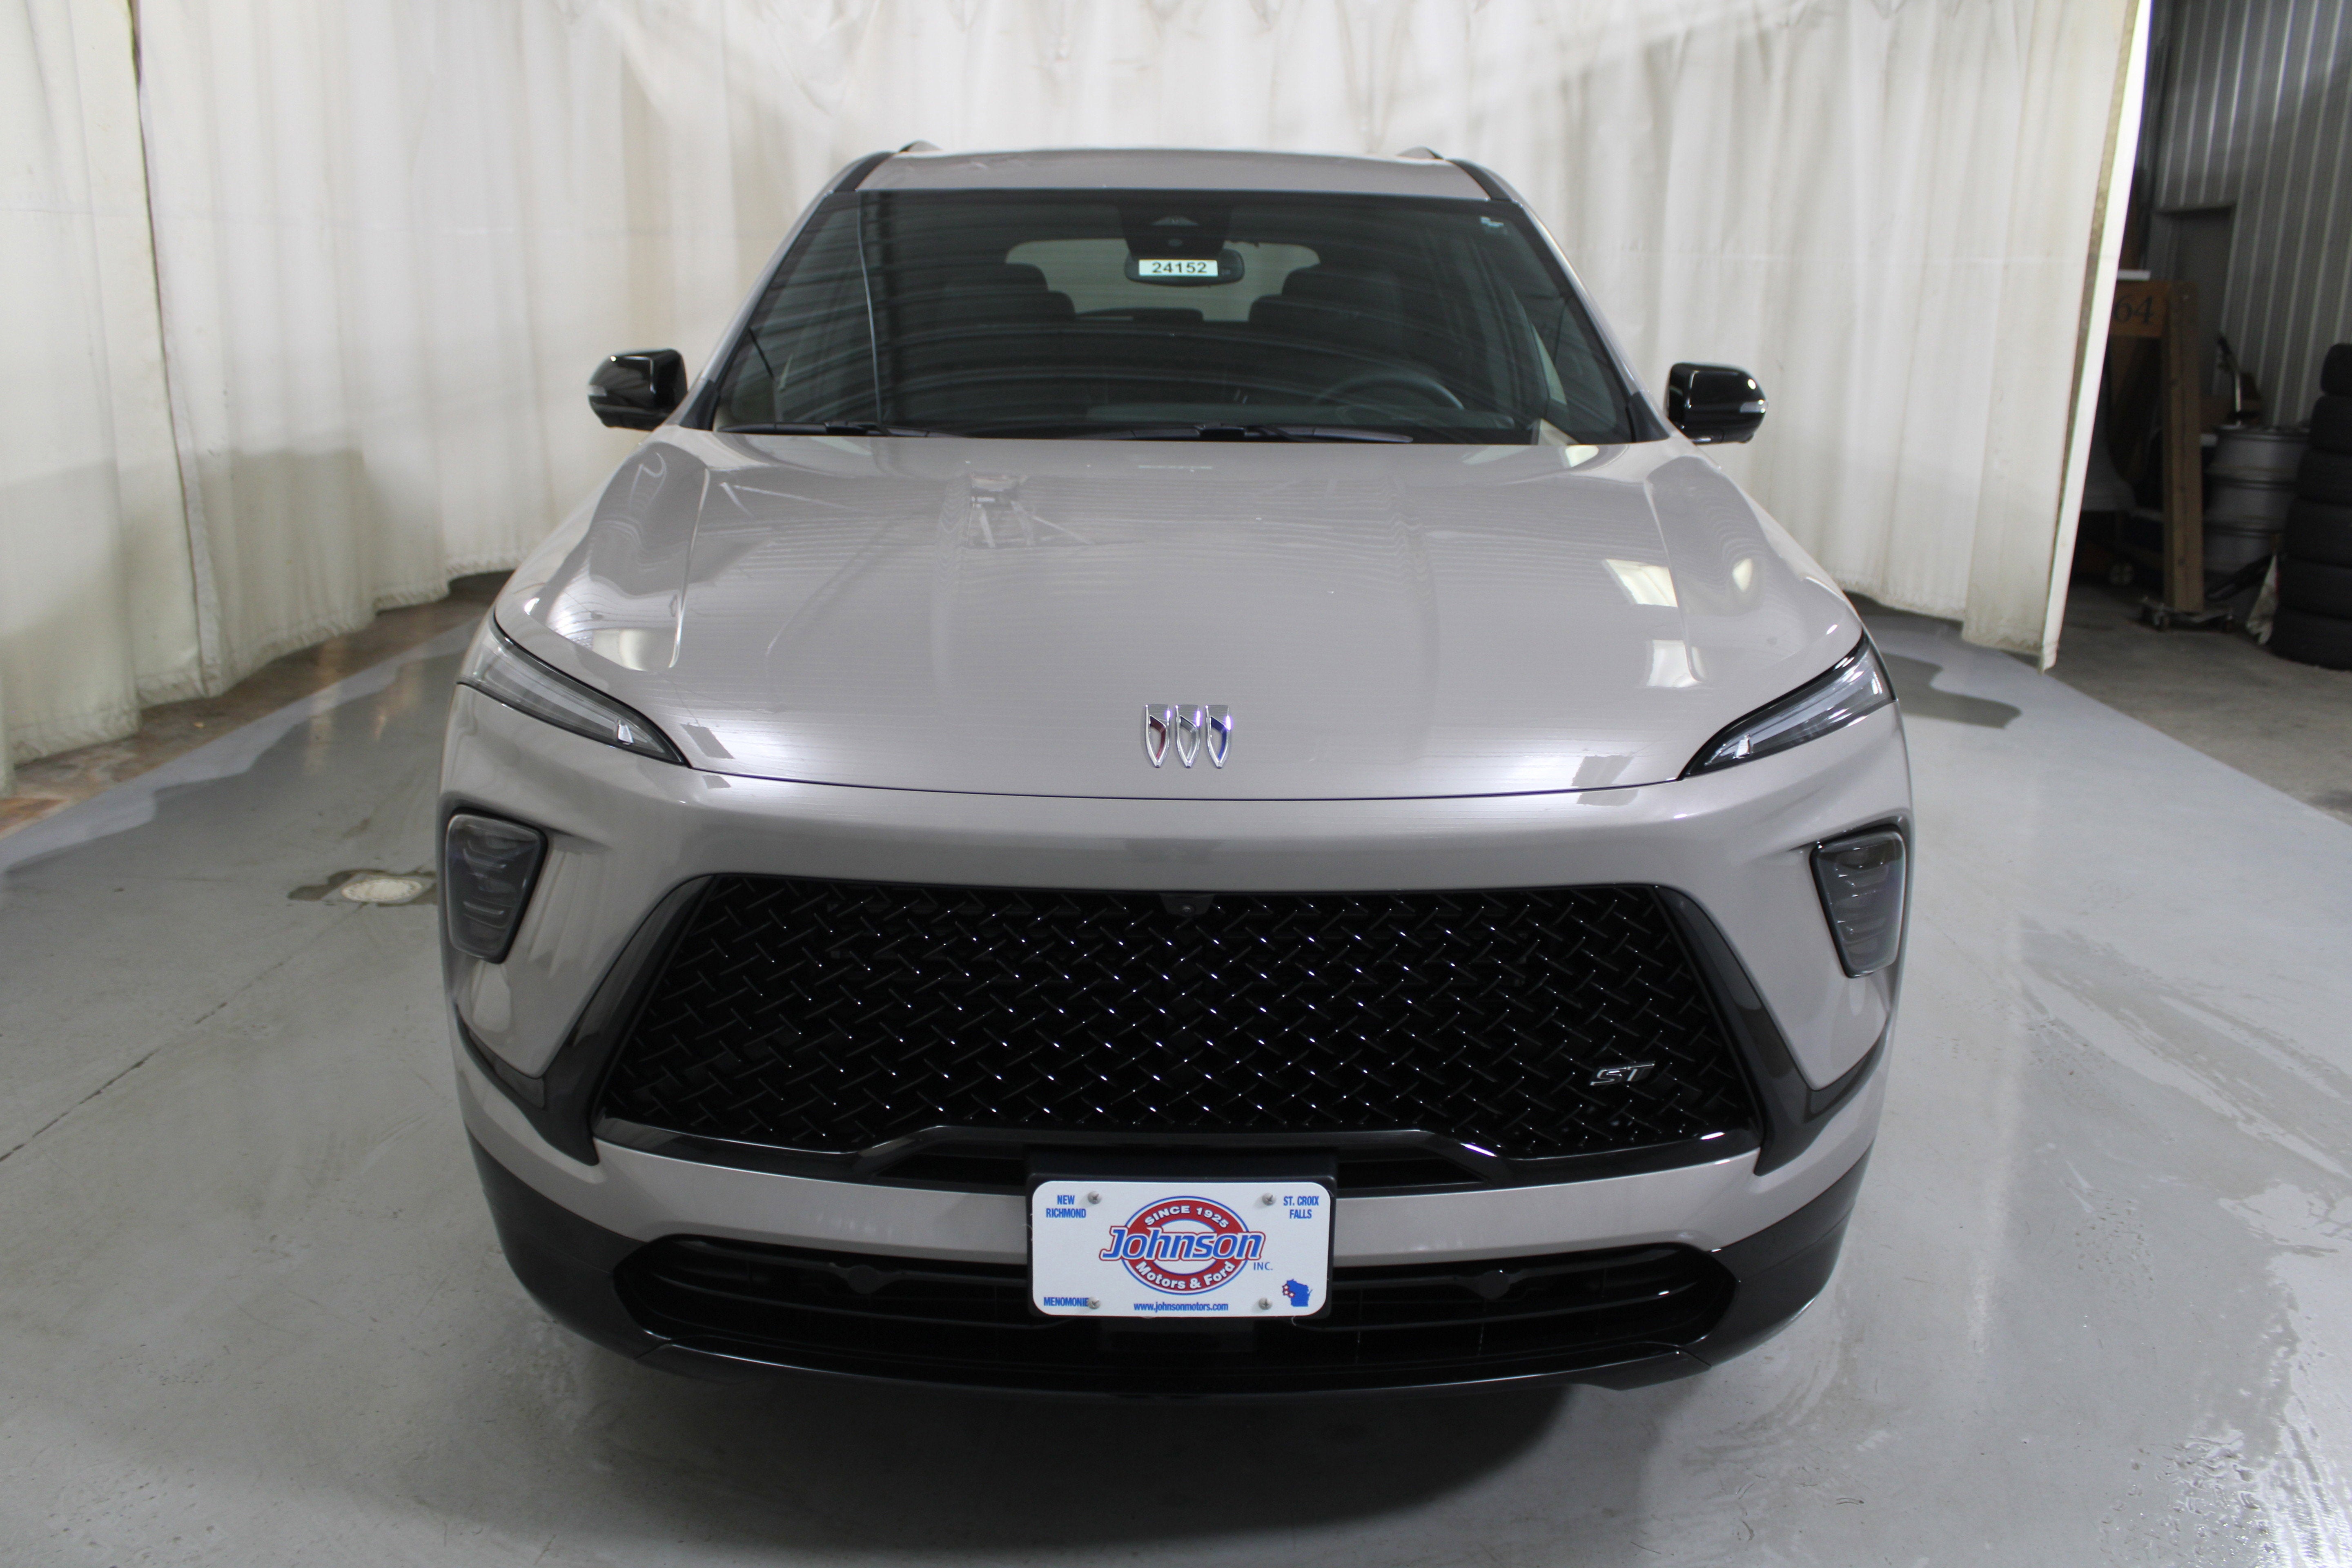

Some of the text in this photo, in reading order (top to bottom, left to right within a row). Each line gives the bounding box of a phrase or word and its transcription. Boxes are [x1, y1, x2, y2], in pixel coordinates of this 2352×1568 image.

[1152, 261, 1207, 274] 24152
[1590, 1061, 1655, 1086] ST
[1057, 1195, 1075, 1205] NEW
[1283, 1196, 1319, 1206] ST. CROIX
[1046, 1208, 1087, 1218] RICHMOND
[1145, 1205, 1229, 1228] SINCE 1925
[1290, 1209, 1312, 1219] FALLS
[1100, 1226, 1266, 1261] Johnson
[1253, 1262, 1273, 1271] INC.
[1136, 1261, 1236, 1290] Motors & Ford
[1044, 1297, 1089, 1307] MENOMONIE
[1134, 1302, 1229, 1313] www.johnsonmotors.com
